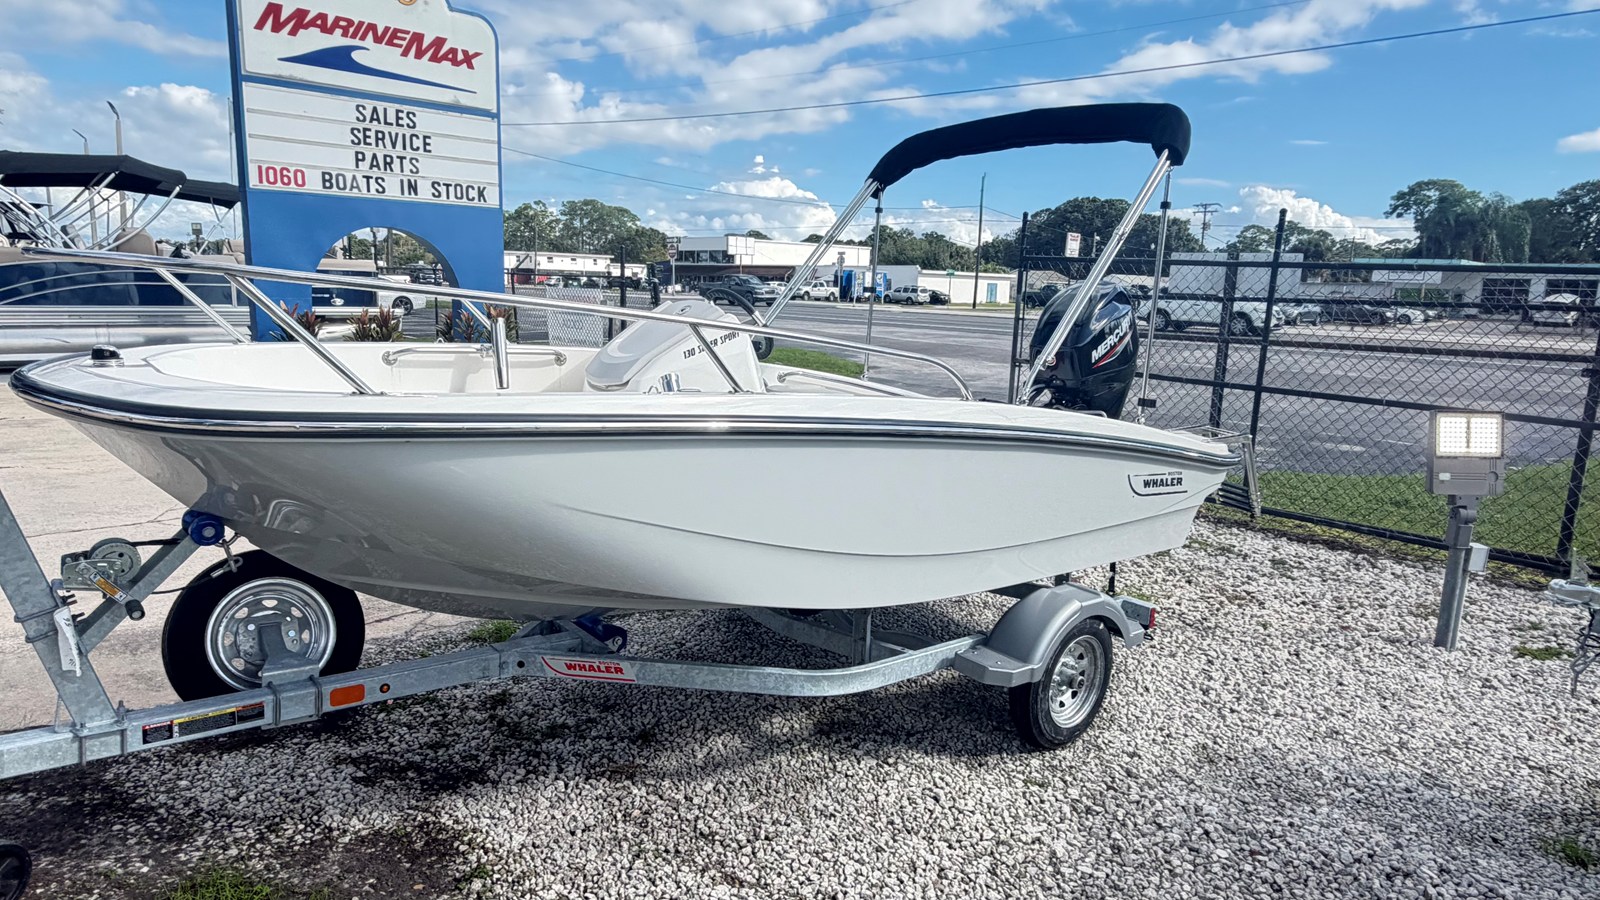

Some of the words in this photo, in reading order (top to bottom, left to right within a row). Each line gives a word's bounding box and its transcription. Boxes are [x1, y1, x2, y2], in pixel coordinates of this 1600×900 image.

[355, 104, 417, 129] SALES
[350, 128, 432, 153] SERVICE
[354, 151, 420, 175] PARTS
[257, 165, 307, 188] 1060
[321, 171, 386, 195] BOATS
[400, 178, 418, 197] IN
[431, 181, 488, 203] STOCK
[683, 347, 696, 359] 130
[1143, 477, 1183, 489] WHALER
[563, 662, 624, 675] WHALER
